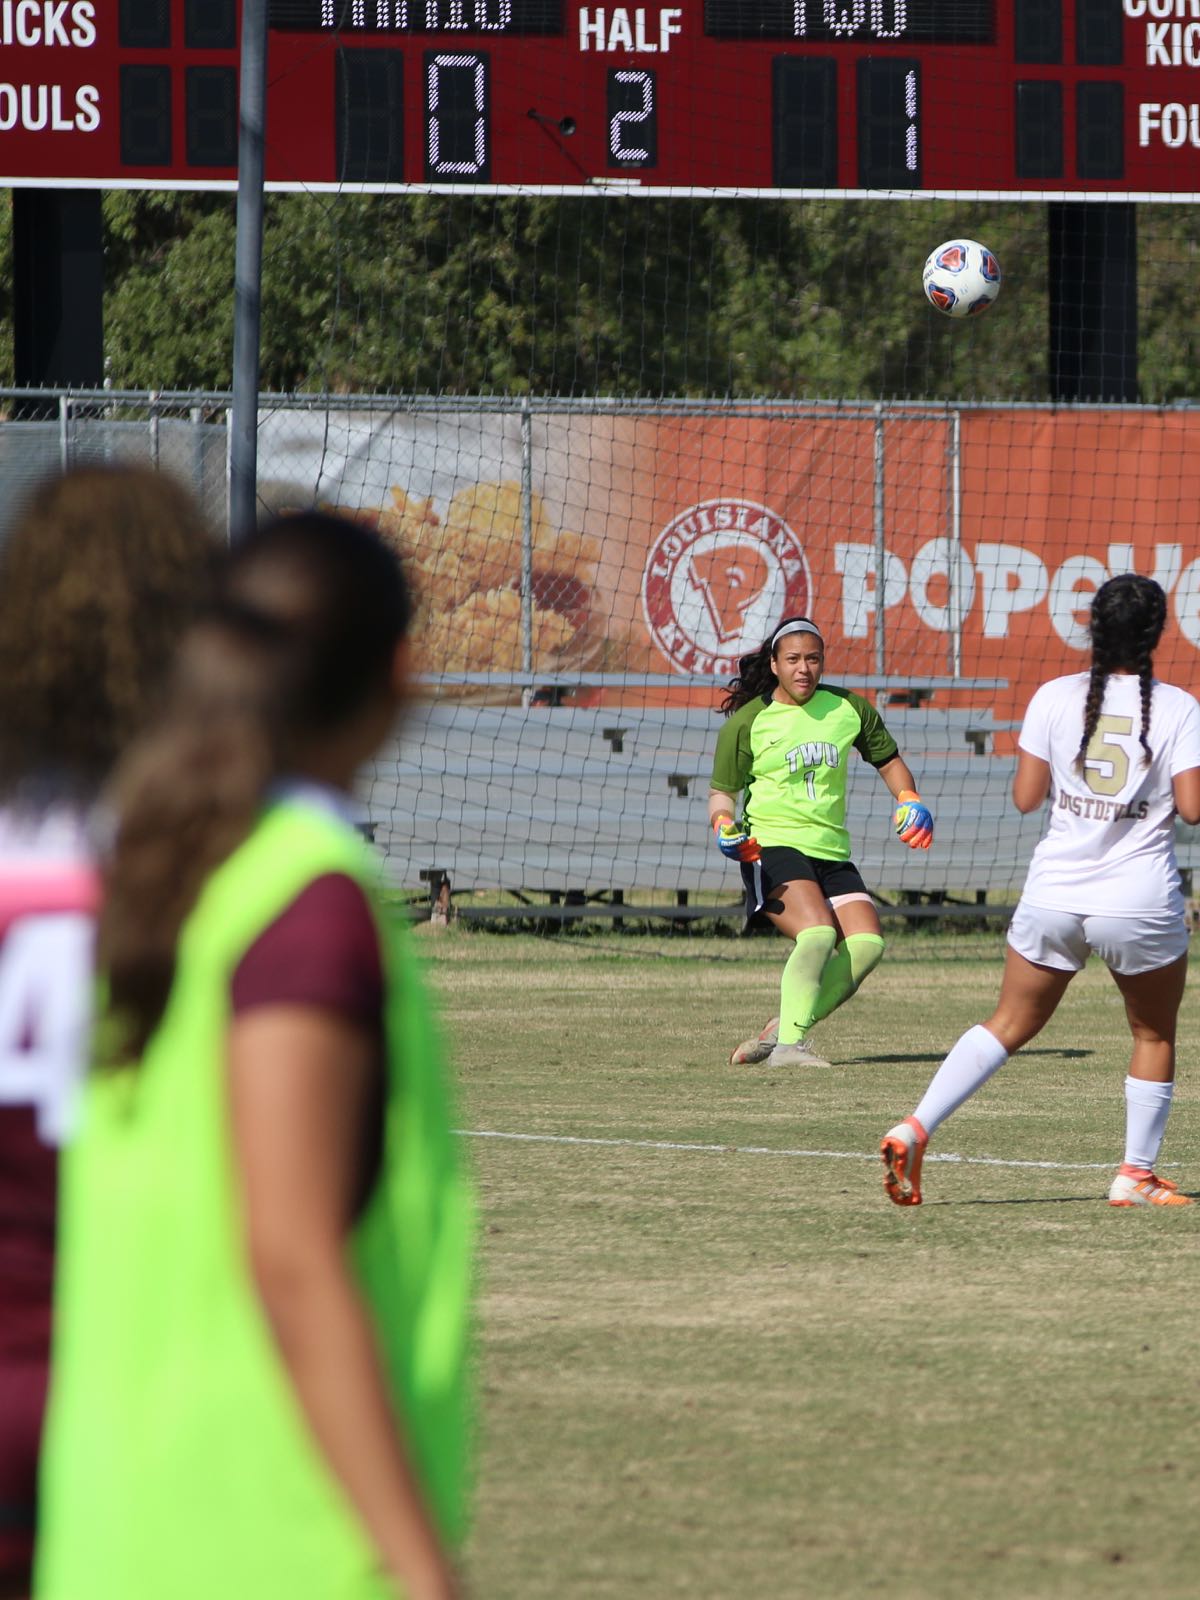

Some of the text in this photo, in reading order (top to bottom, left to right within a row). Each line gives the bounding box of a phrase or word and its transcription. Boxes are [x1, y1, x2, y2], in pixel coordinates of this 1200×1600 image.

[0, 0, 97, 47] ICKS
[579, 7, 682, 53] HALF
[428, 55, 485, 174] 0
[610, 71, 653, 160] 2
[905, 70, 917, 170] 1
[651, 505, 802, 582] LOUISIANA
[785, 741, 839, 774] TWU
[804, 771, 817, 801] 1
[1083, 713, 1134, 797] 5
